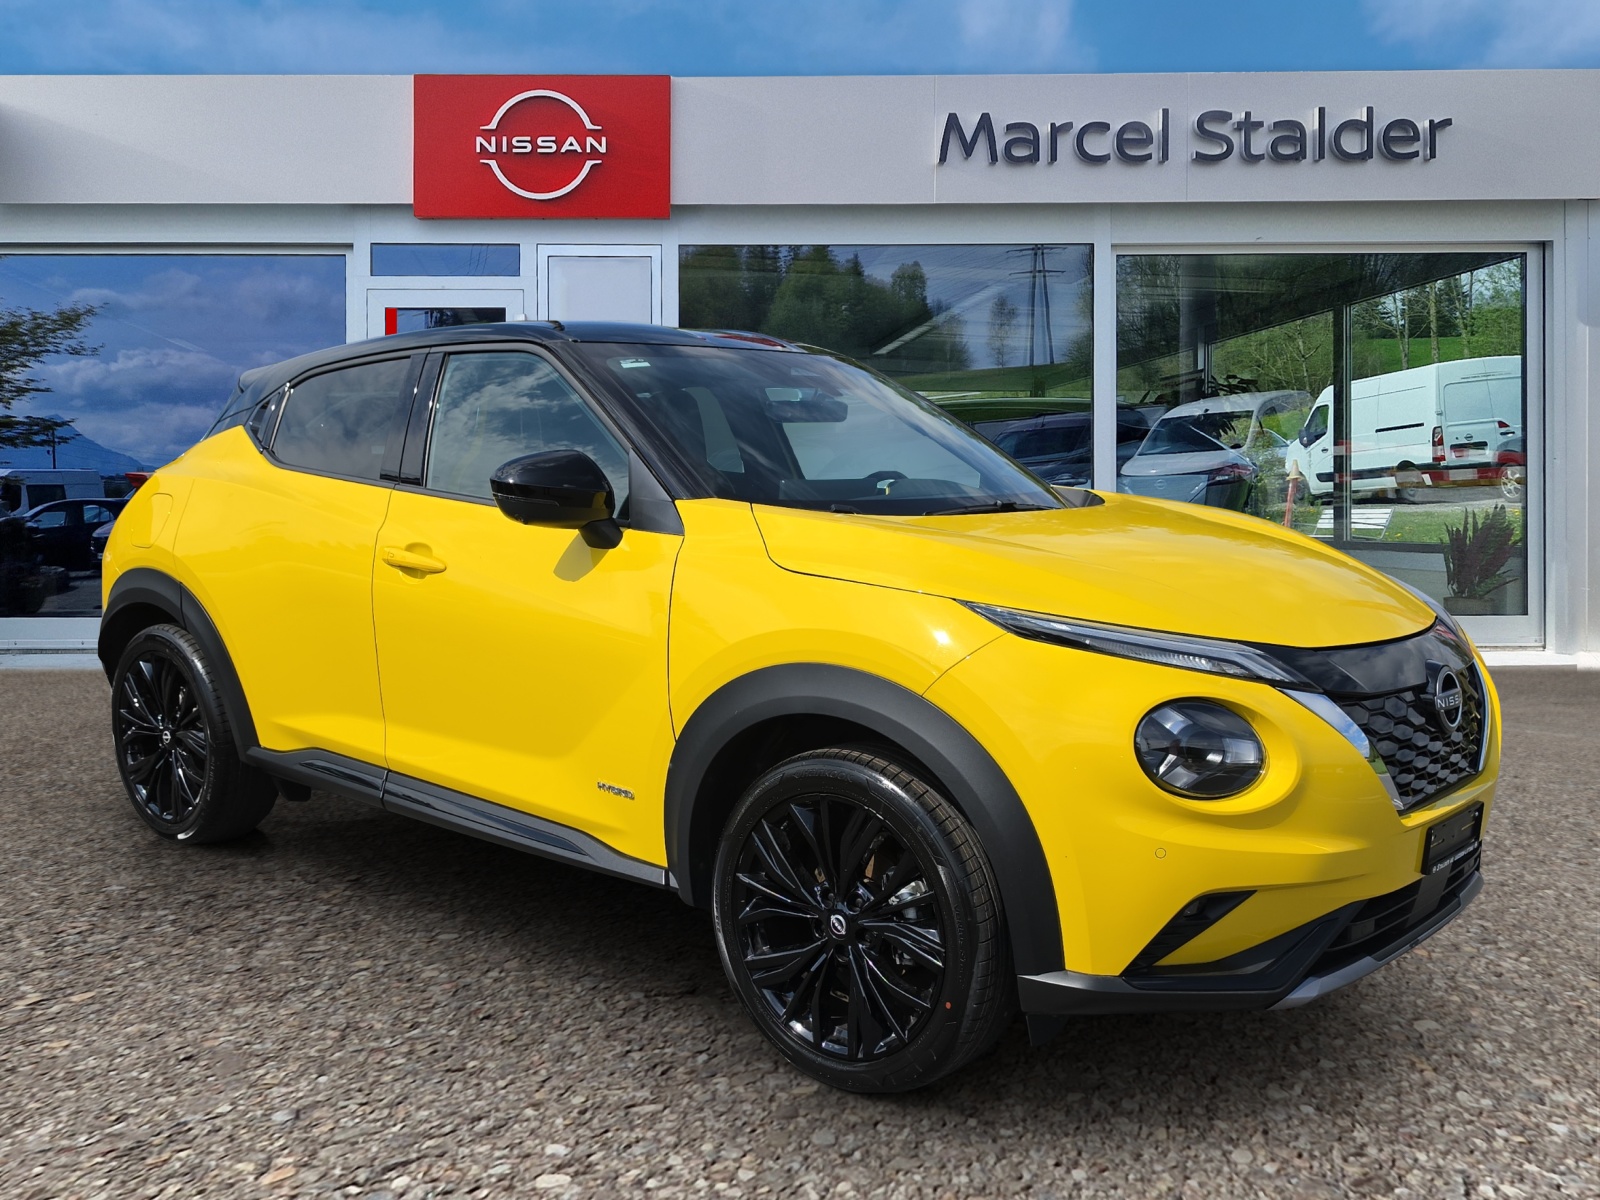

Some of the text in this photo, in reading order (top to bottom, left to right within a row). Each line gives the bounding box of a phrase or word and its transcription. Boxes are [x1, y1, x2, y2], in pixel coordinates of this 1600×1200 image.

[937, 105, 1453, 166] Marcel Stalder
[475, 136, 607, 153] NISSAN
[1437, 694, 1460, 709] NISS
